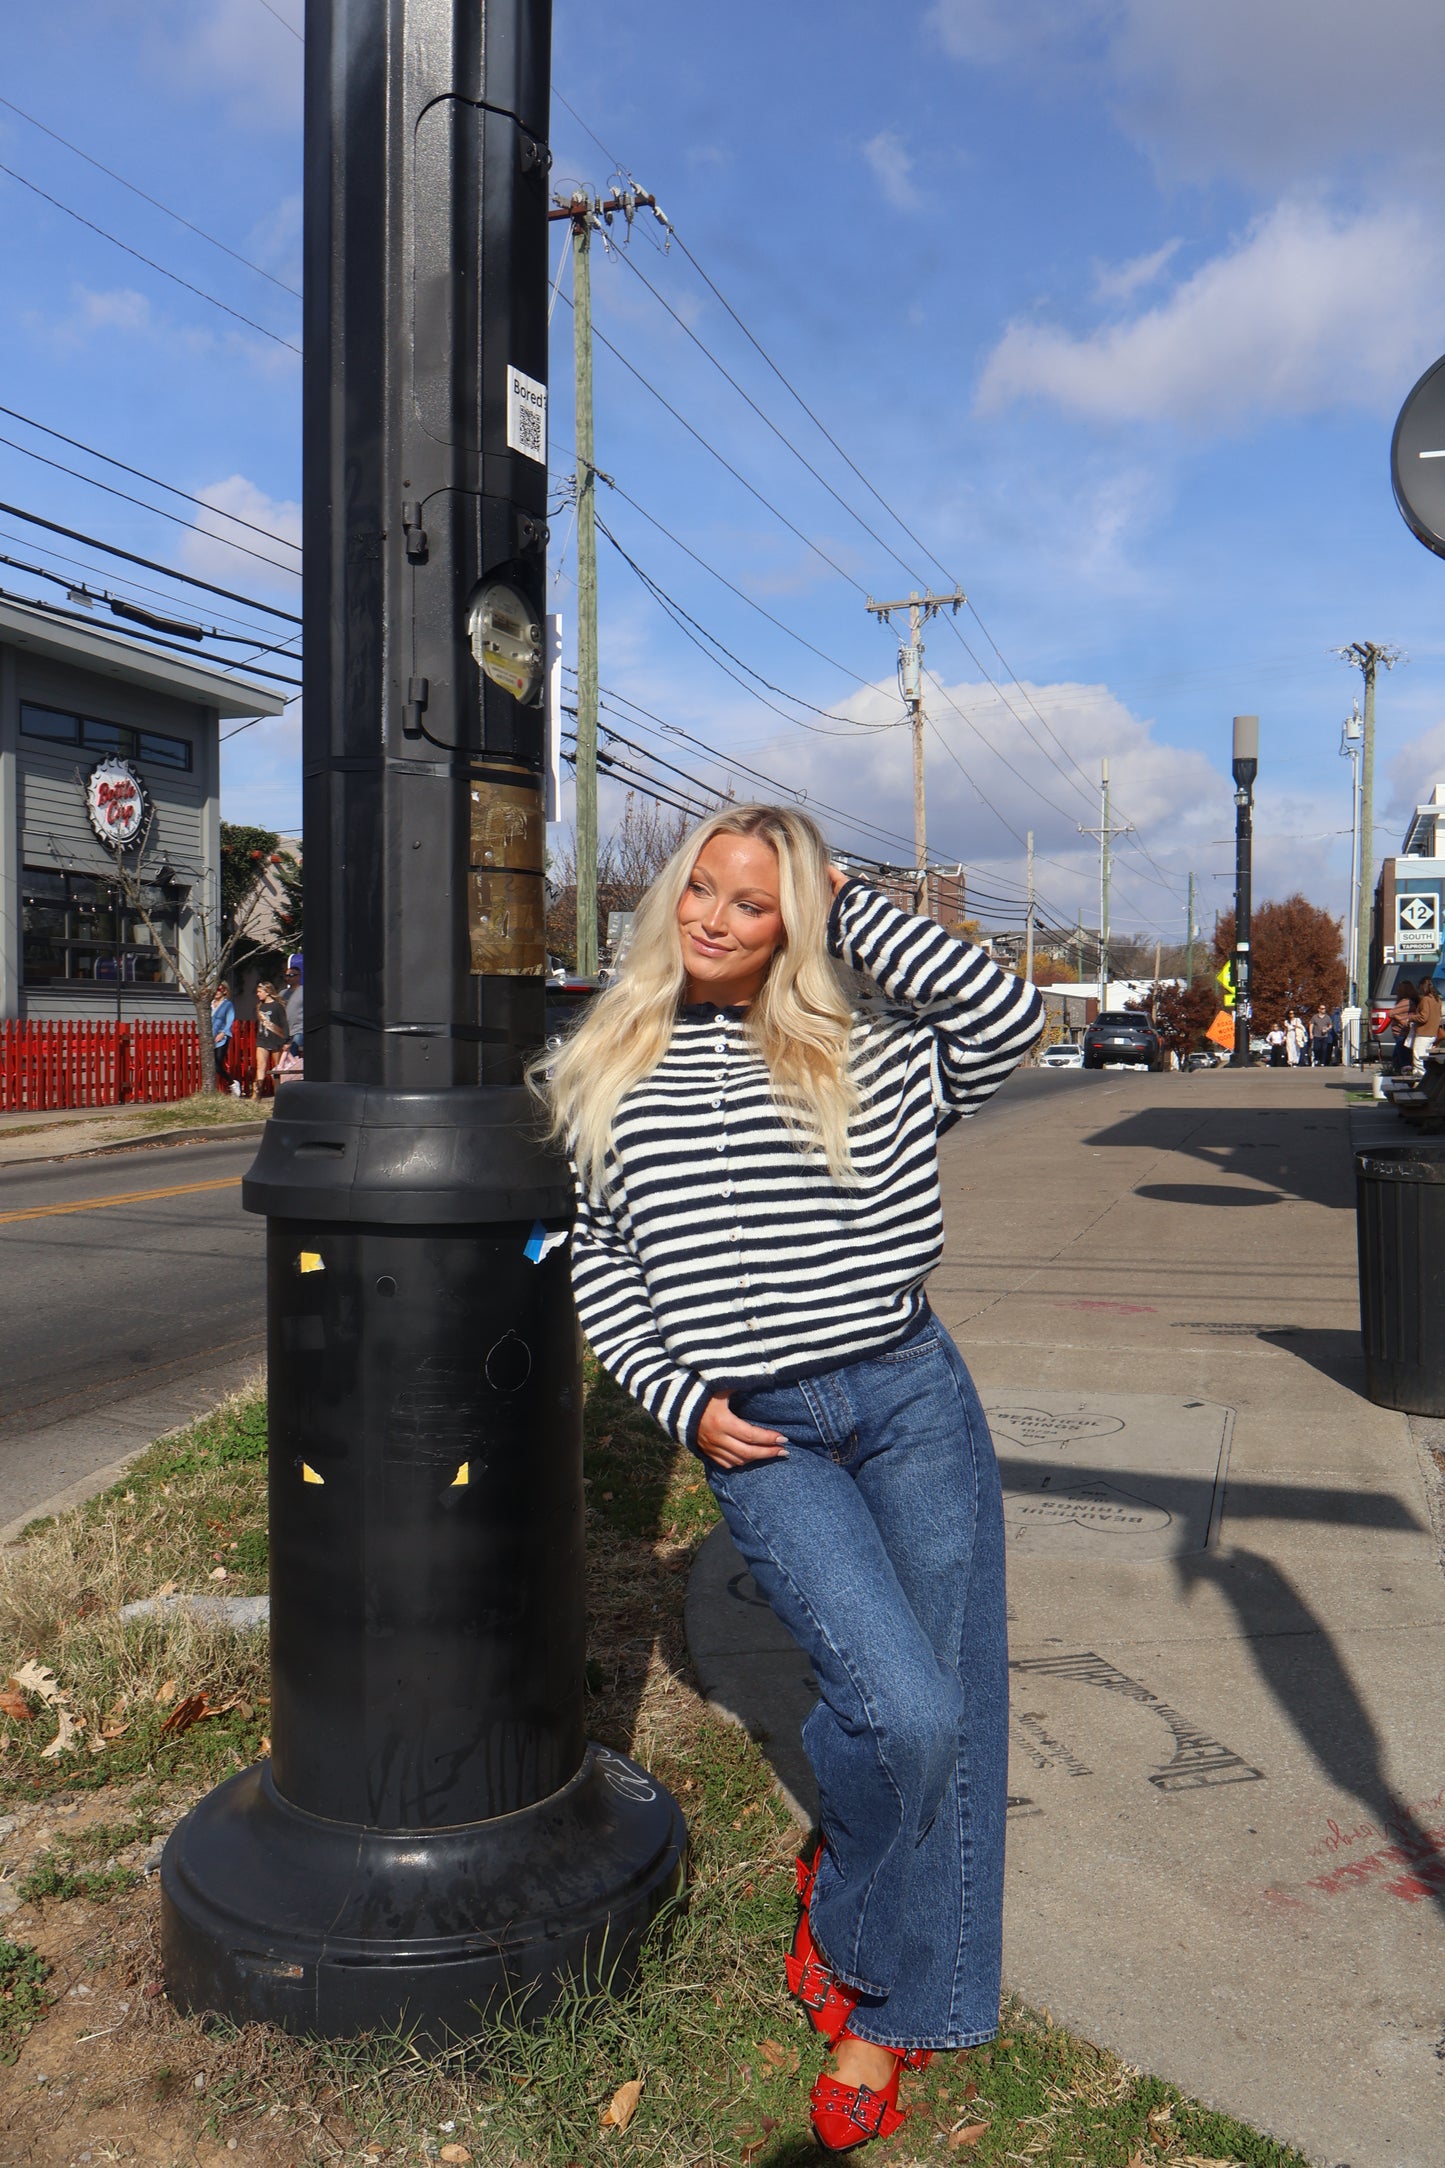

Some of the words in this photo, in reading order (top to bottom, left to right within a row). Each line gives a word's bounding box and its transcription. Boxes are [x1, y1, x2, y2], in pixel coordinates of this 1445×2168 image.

[1408, 906, 1427, 920] 12
[1402, 933, 1433, 941] SOUTH
[1402, 943, 1433, 951] TAPROOM
[998, 1413, 1100, 1426] BEAUTIFUL
[1010, 1420, 1081, 1430] THINGS
[1042, 1502, 1123, 1513] THINGS
[1018, 1506, 1143, 1523] BEAUTIFUL
